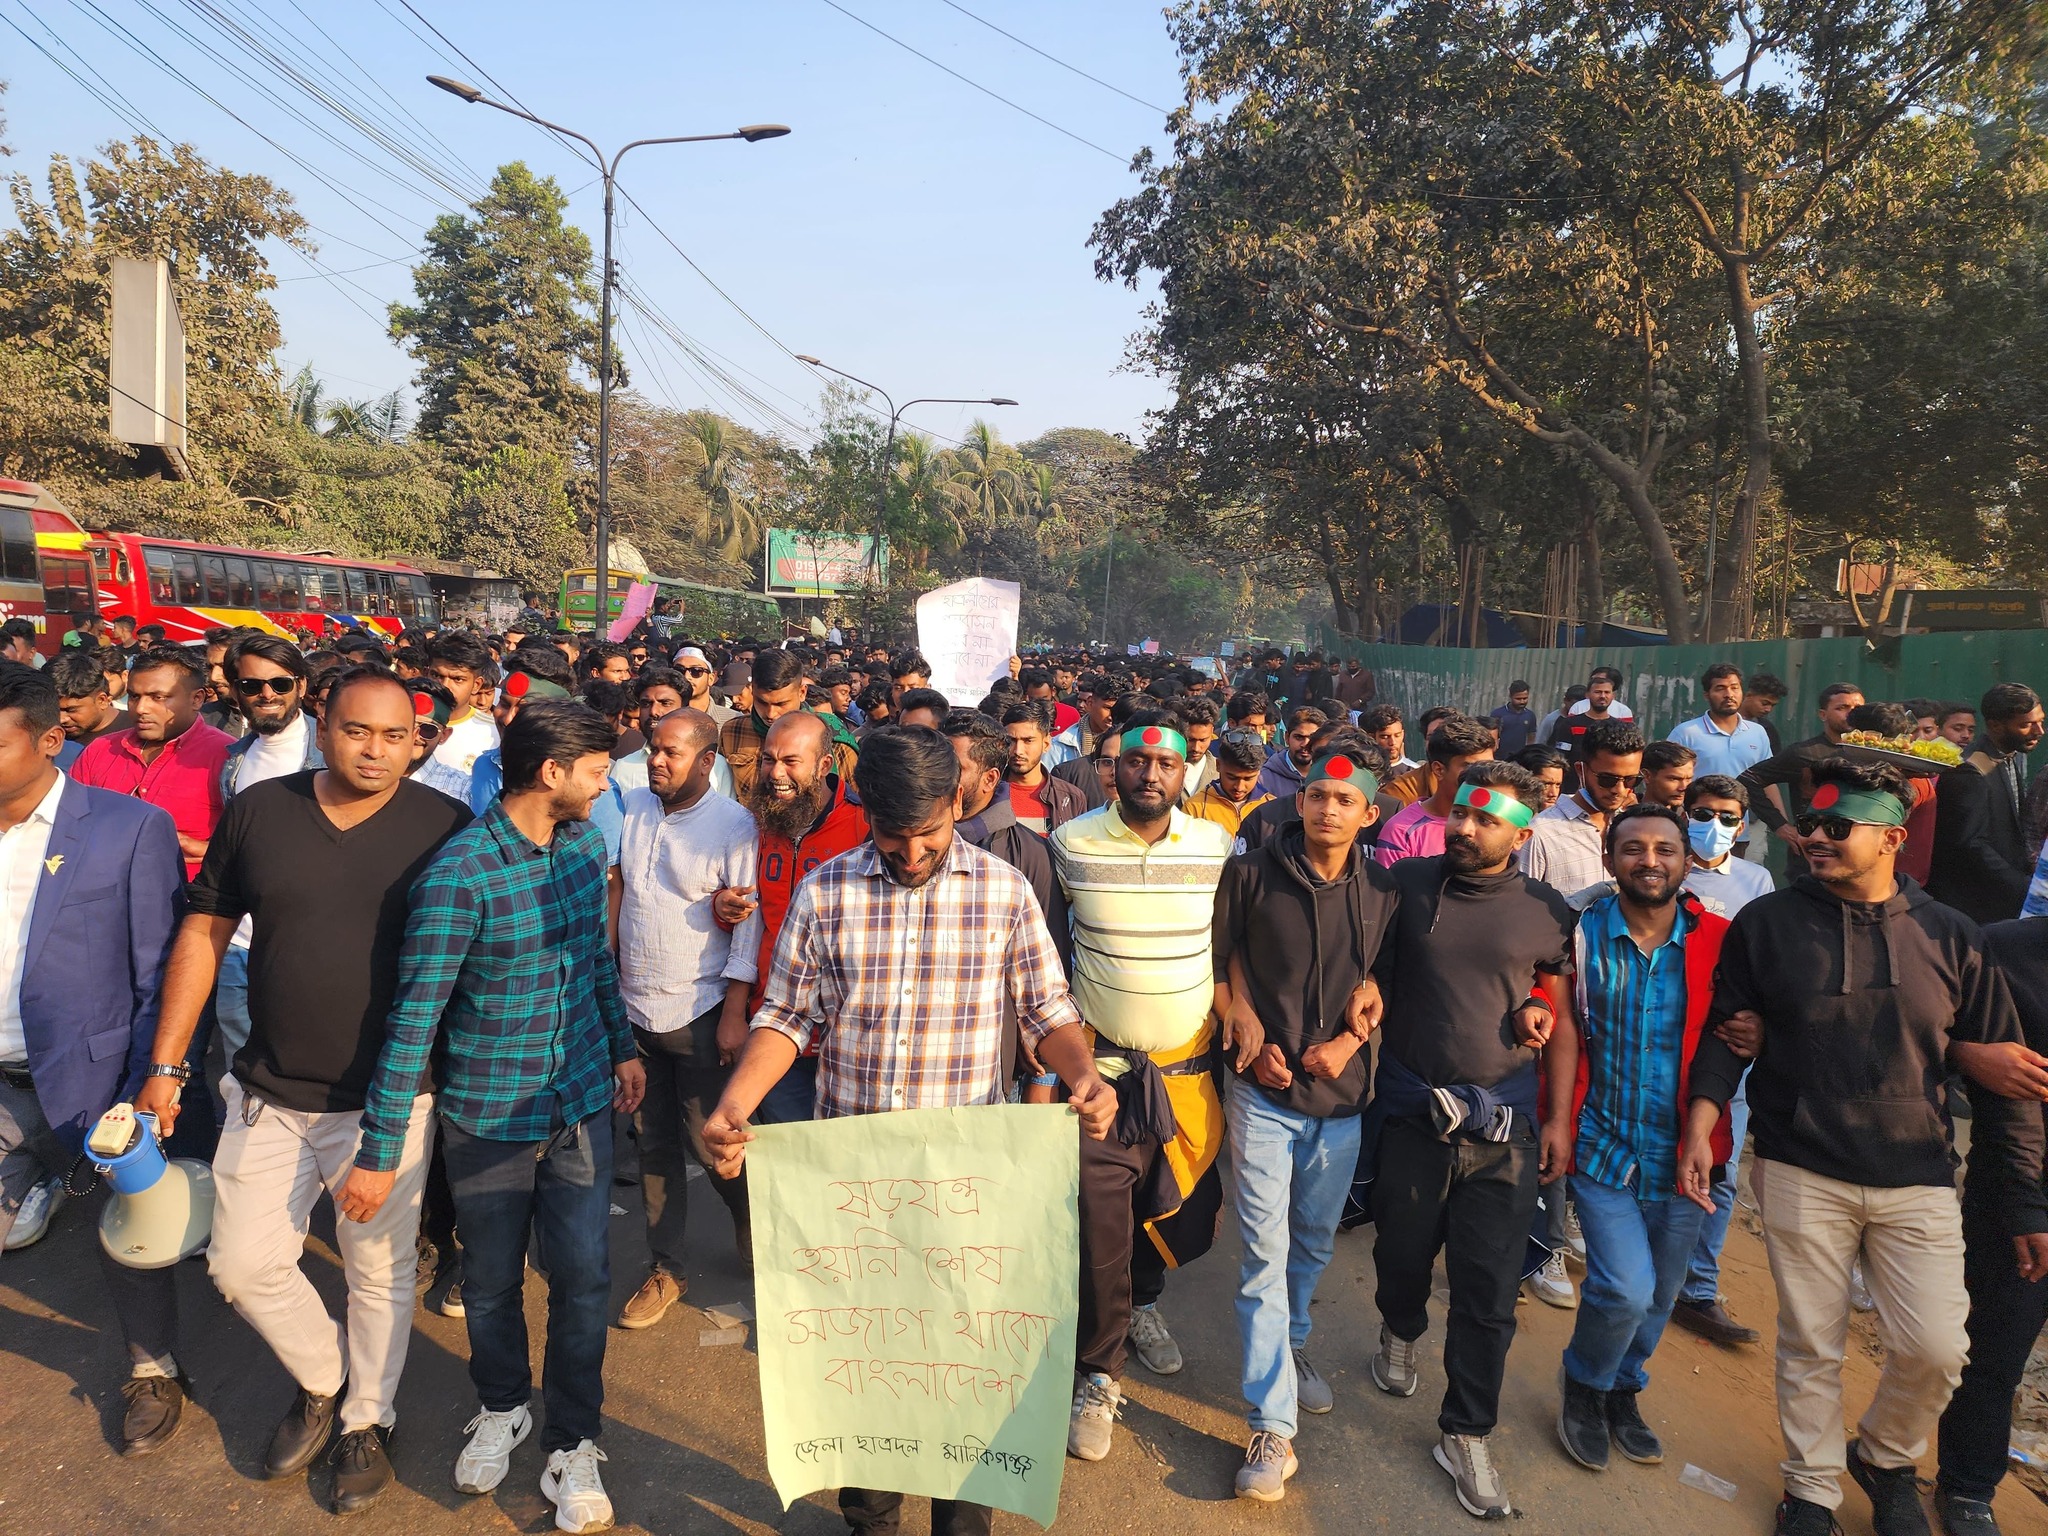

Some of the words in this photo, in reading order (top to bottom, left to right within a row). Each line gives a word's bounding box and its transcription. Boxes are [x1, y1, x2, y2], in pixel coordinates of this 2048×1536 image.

[828, 1176, 1002, 1219] ষড়যন্ত্র
[793, 1227, 907, 1286] হয়নি
[921, 1246, 1025, 1291] শেষ
[784, 1307, 935, 1354] সজাগ
[953, 1310, 1063, 1367] থাকো
[824, 1358, 1028, 1414] বাংলাদেশ
[794, 1436, 845, 1464] জেলা
[852, 1434, 924, 1458] ছাত্রদল
